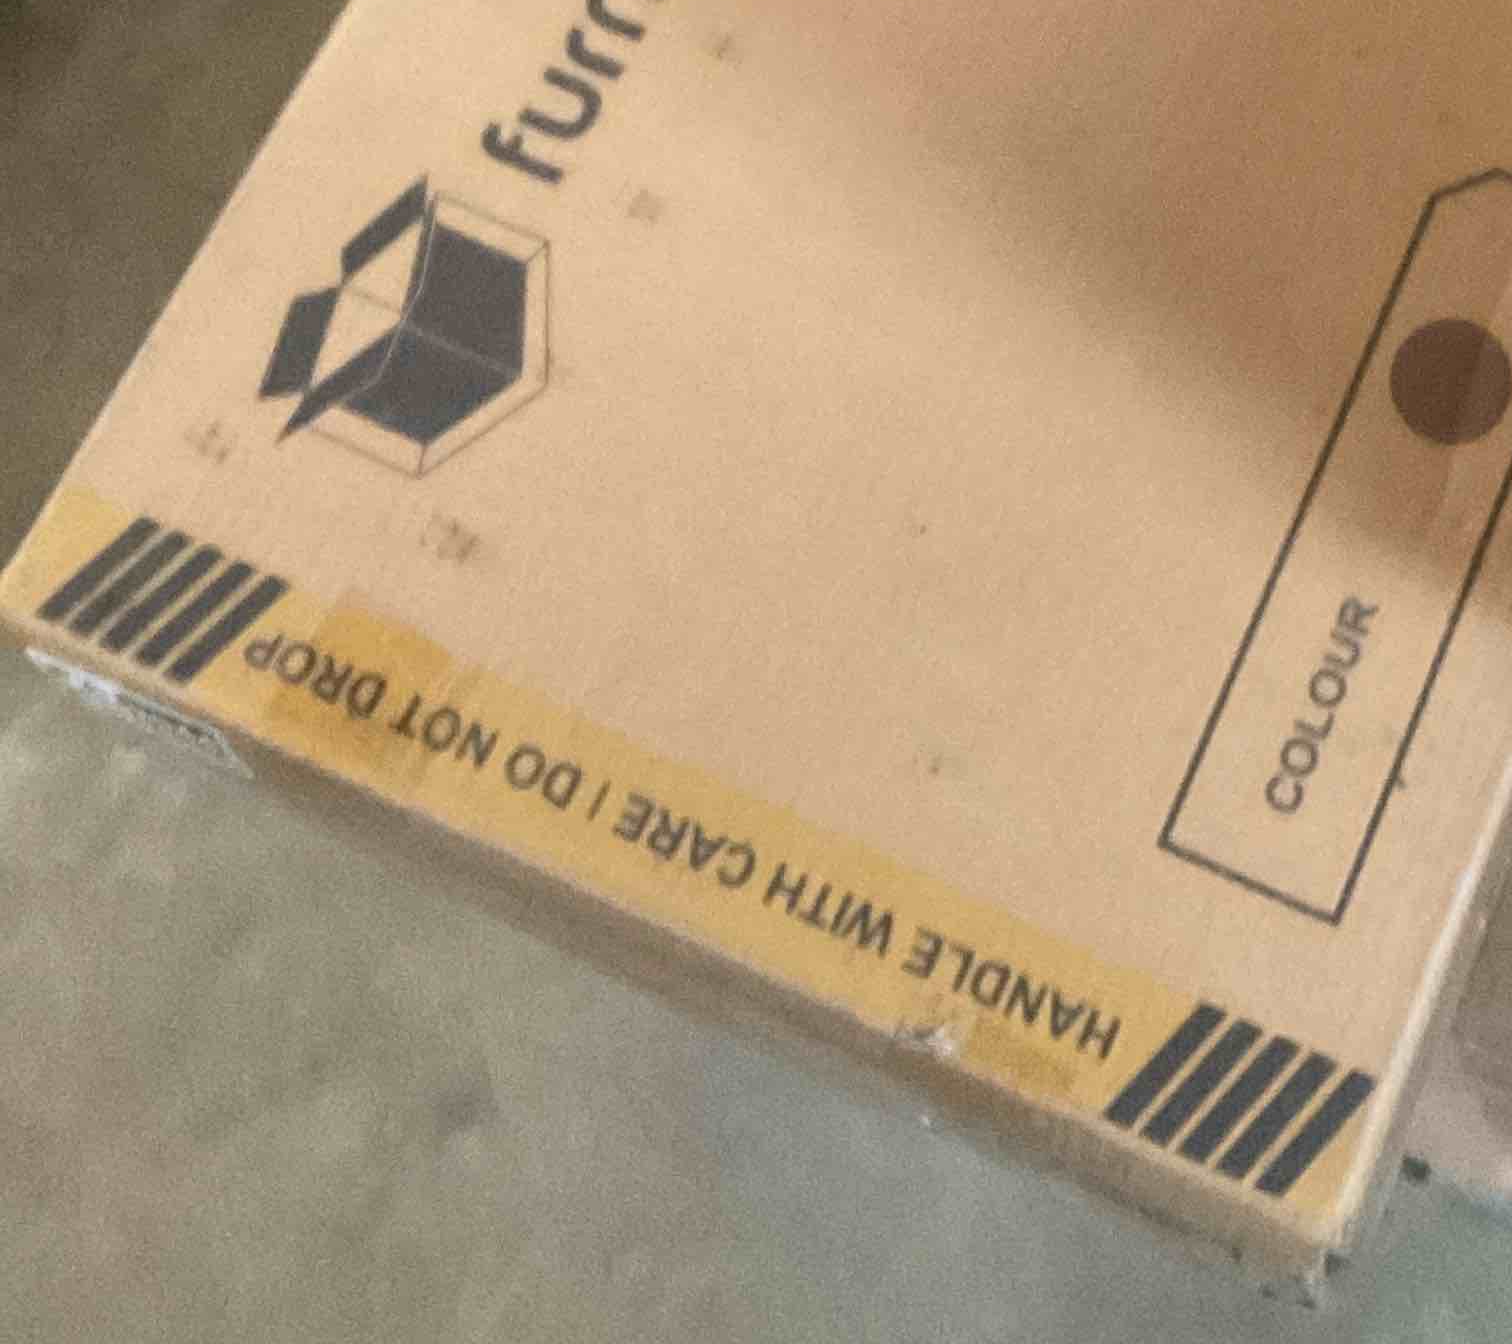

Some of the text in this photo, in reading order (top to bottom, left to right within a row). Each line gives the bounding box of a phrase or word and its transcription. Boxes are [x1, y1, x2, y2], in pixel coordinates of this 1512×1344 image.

[242, 631, 389, 721] DROP
[1265, 596, 1380, 814] COLOUR
[391, 693, 501, 769] NOT
[504, 744, 586, 811] DO
[611, 790, 757, 889] CARE
[763, 861, 895, 960] WITH
[900, 925, 1122, 1061] HANDLE
